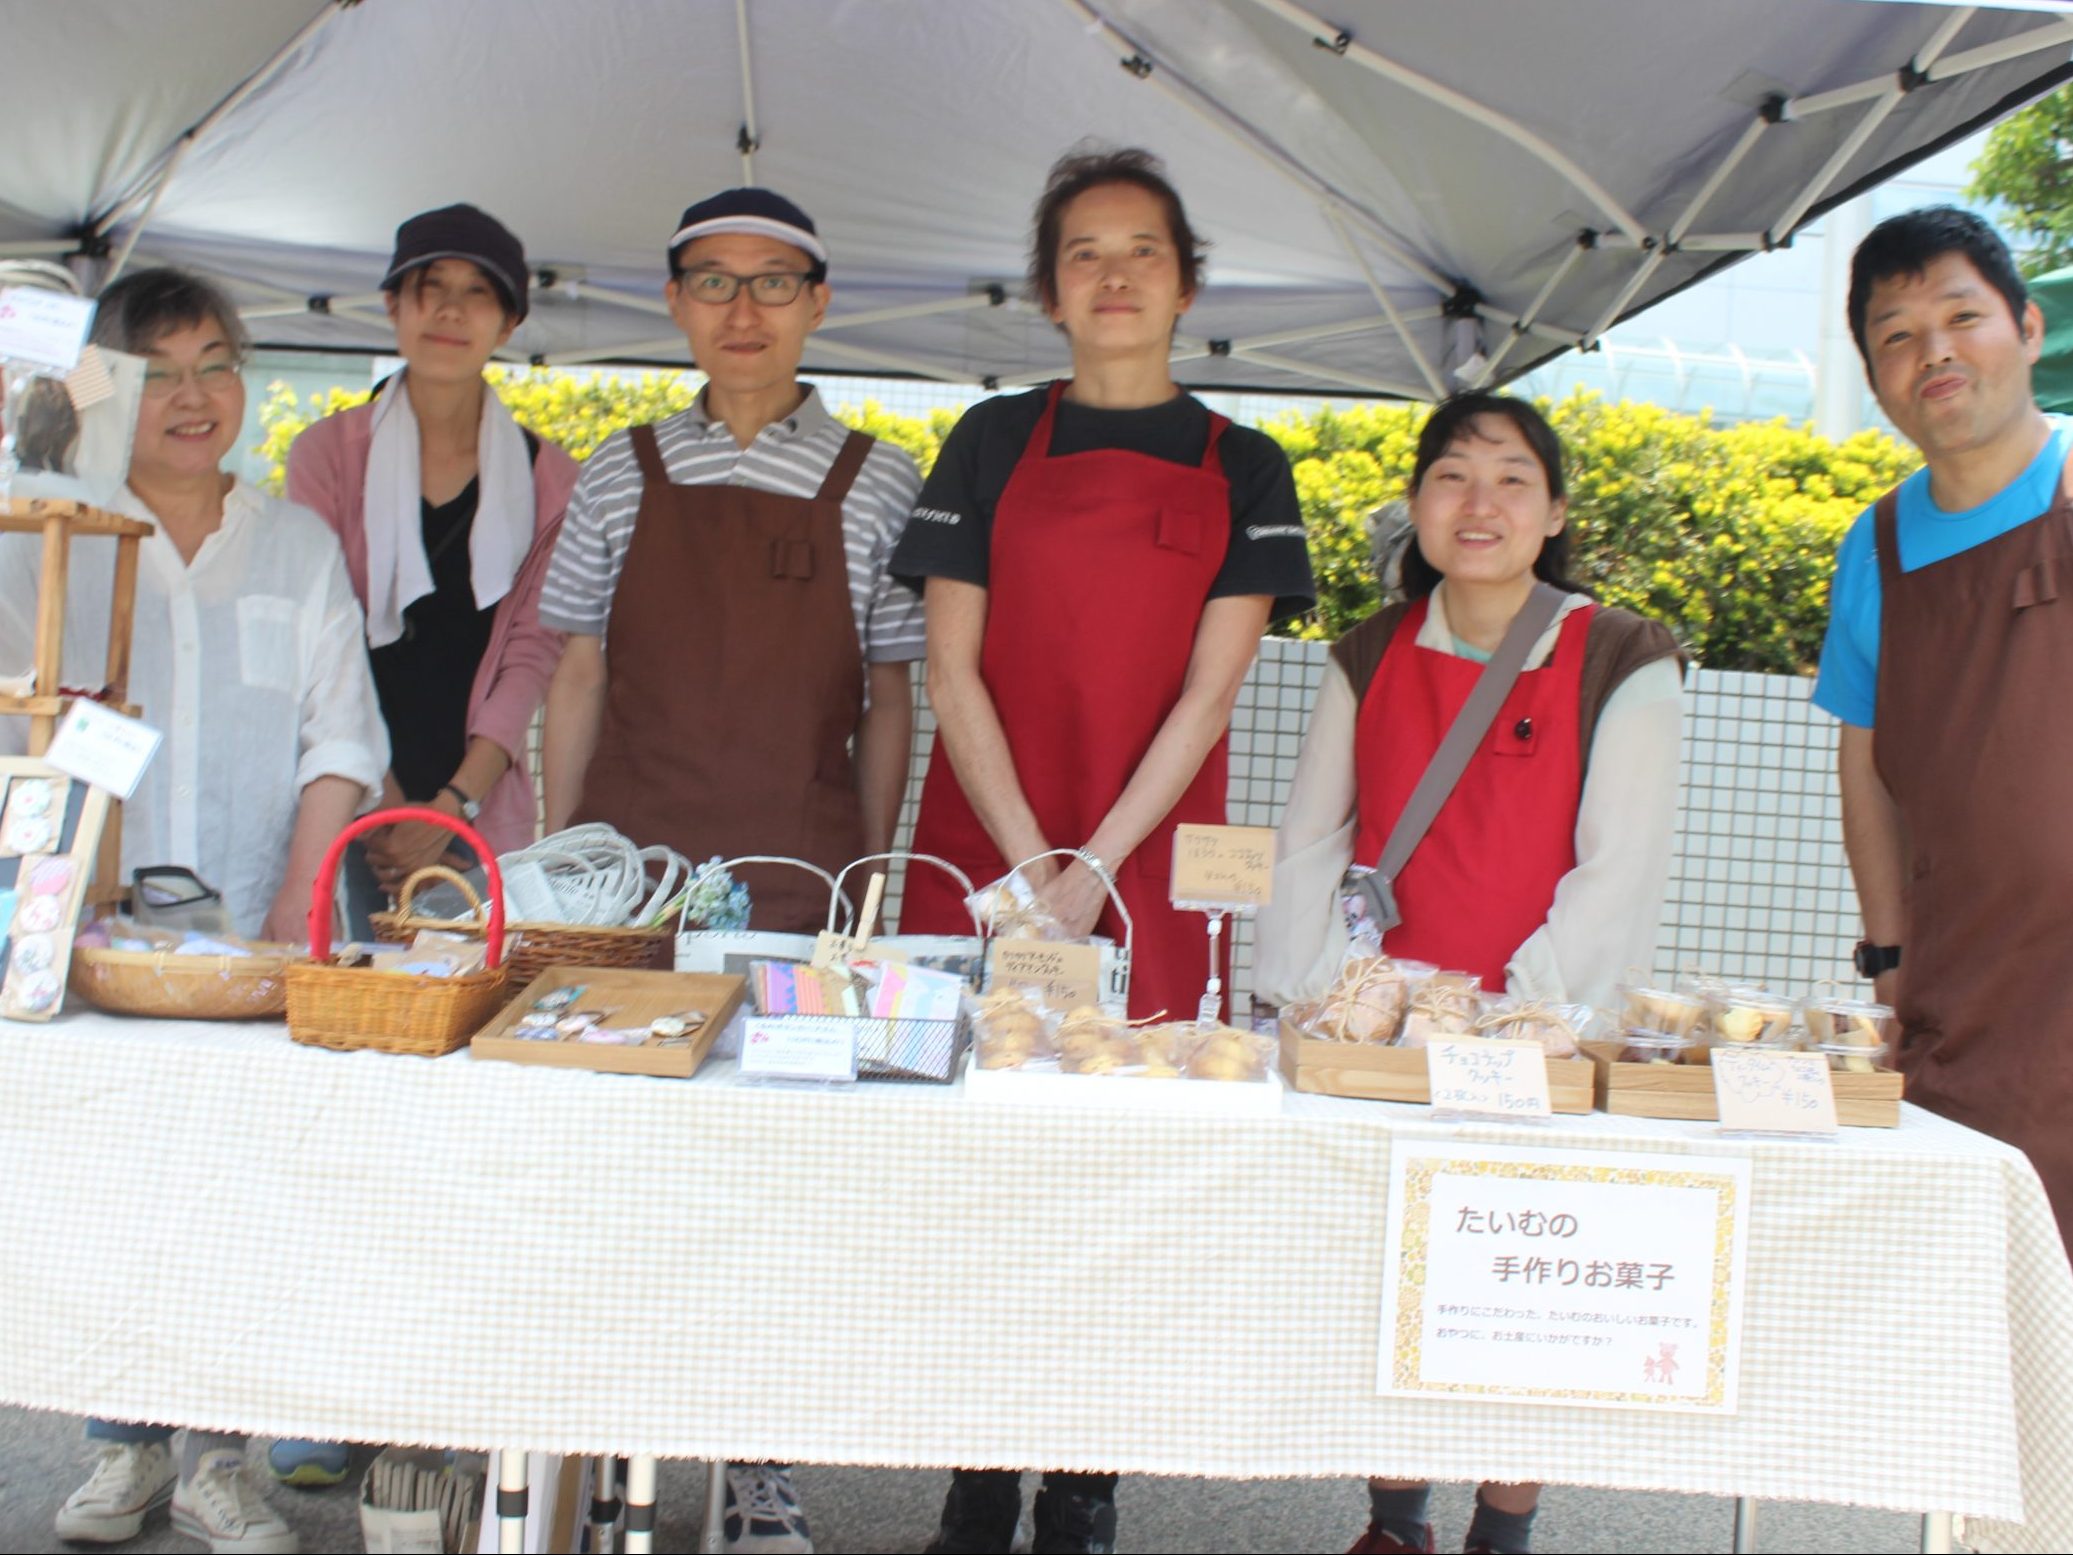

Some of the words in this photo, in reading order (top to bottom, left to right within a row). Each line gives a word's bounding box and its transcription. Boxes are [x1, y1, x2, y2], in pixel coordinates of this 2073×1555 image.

[1440, 1044, 1515, 1068] チョコチップ
[1467, 1069, 1513, 1086] クッキー
[1498, 1092, 1541, 1109] 150円
[1456, 1205, 1578, 1238] たいむの
[1491, 1255, 1676, 1291] 手作りお菓子
